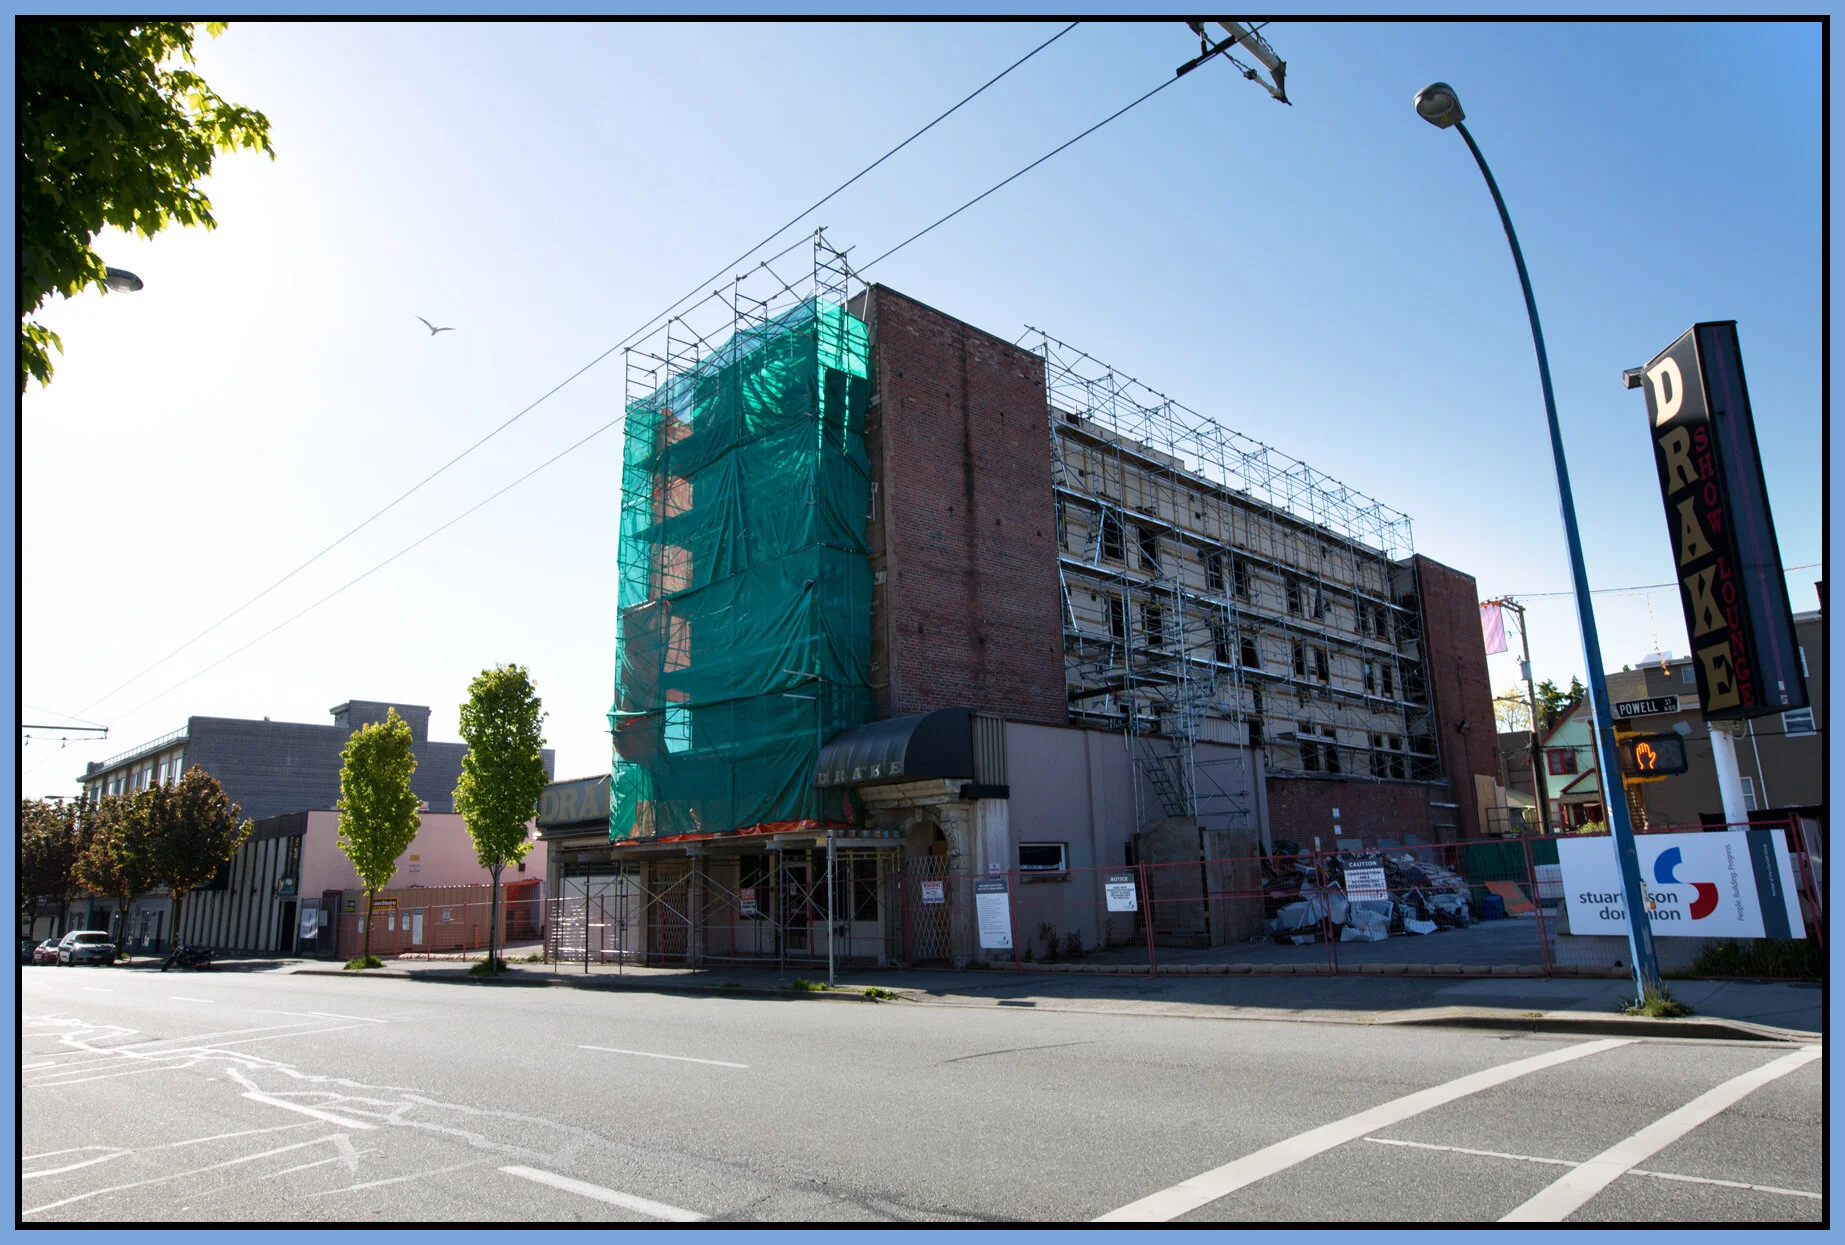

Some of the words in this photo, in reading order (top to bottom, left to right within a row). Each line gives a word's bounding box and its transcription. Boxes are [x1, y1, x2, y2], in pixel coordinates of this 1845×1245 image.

[1647, 357, 1740, 712] DRAKE
[1694, 425, 1722, 535] SHOW
[1716, 557, 1754, 707] LOUNGE
[816, 761, 901, 787] DRAKE
[1619, 700, 1659, 716] POWELL
[1664, 698, 1671, 706] ST
